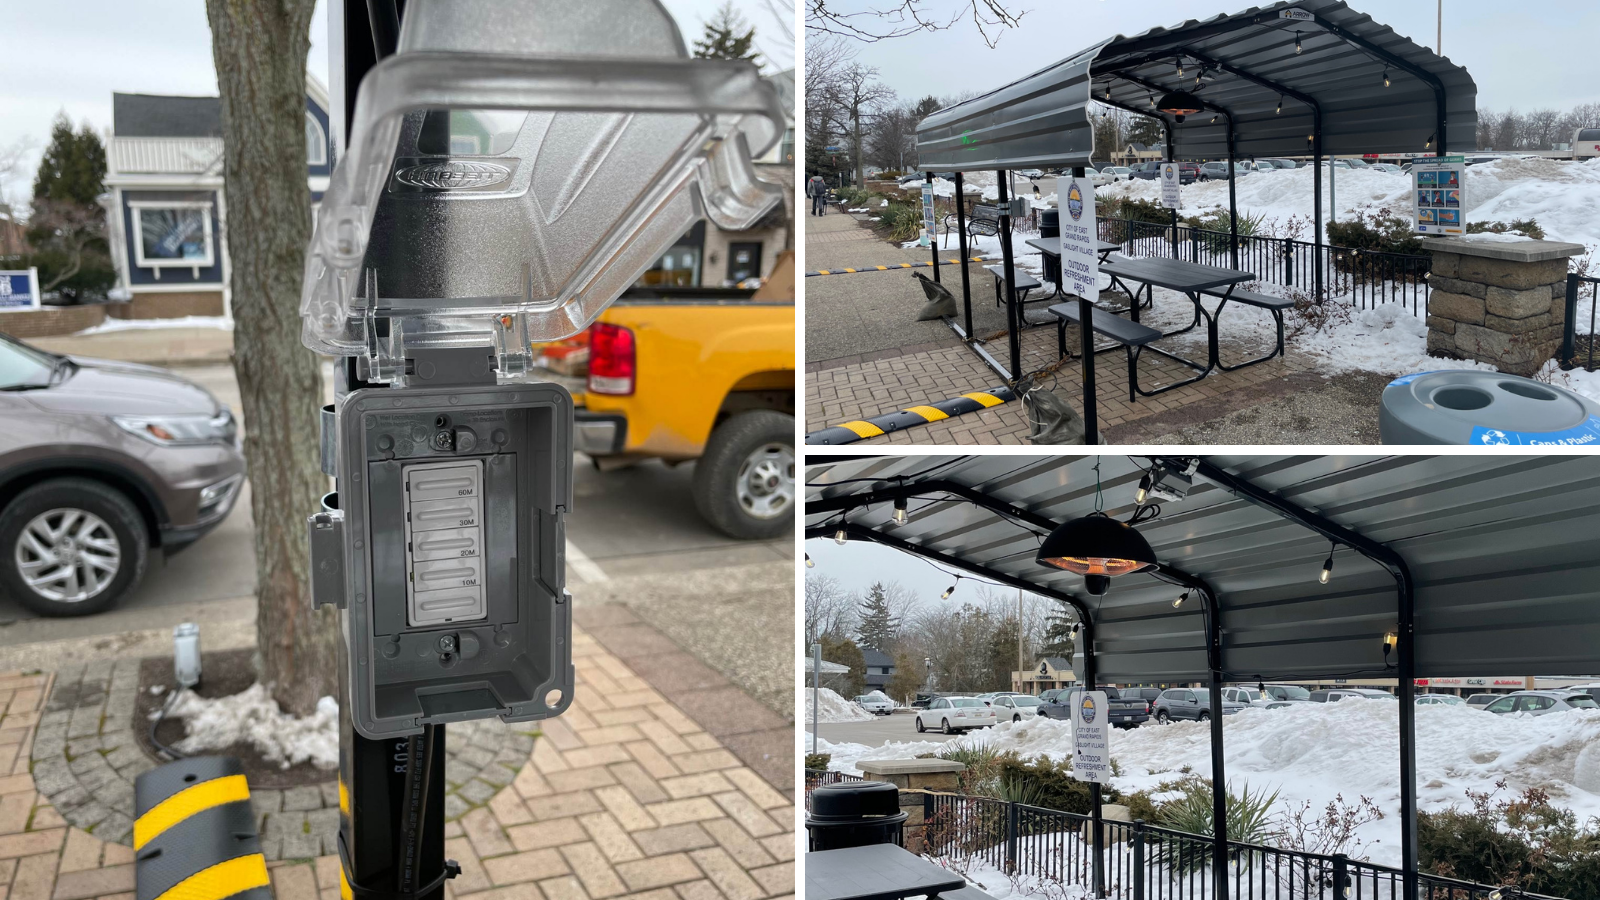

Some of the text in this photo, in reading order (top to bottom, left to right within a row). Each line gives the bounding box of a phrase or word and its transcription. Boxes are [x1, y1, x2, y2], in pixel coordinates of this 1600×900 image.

[1073, 225, 1078, 233] OF
[1078, 226, 1088, 235] EAST
[1065, 232, 1090, 244] GRAND RAPIDS
[1063, 243, 1094, 257] GASLIGHT VILLAGE
[1068, 259, 1090, 274] OUTDOOR
[1064, 269, 1095, 287] REFRESHMENT
[1073, 282, 1086, 294] AREA
[1567, 434, 1596, 445] Plastic
[460, 549, 475, 557] 20M
[394, 735, 409, 773] 803
[1080, 754, 1101, 762] OUTDOOR
[1076, 762, 1107, 772] REFRESHMENT
[1085, 771, 1098, 779] AREA
